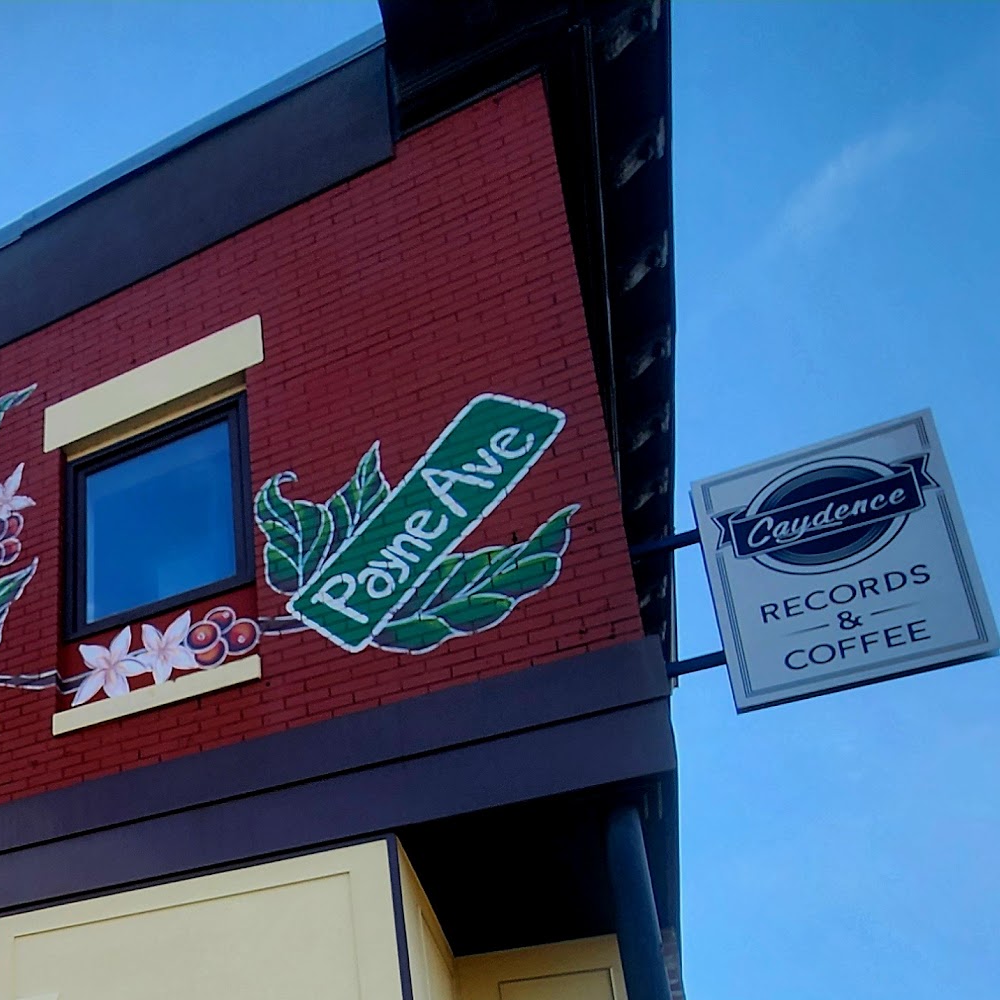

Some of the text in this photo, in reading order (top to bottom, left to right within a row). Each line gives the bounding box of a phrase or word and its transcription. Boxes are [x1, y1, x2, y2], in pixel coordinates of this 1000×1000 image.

[310, 426, 535, 624] Payne Ave
[747, 487, 906, 549] Caydence
[760, 564, 931, 623] RECORDS
[838, 610, 863, 630] &
[784, 619, 931, 670] COFFEE
